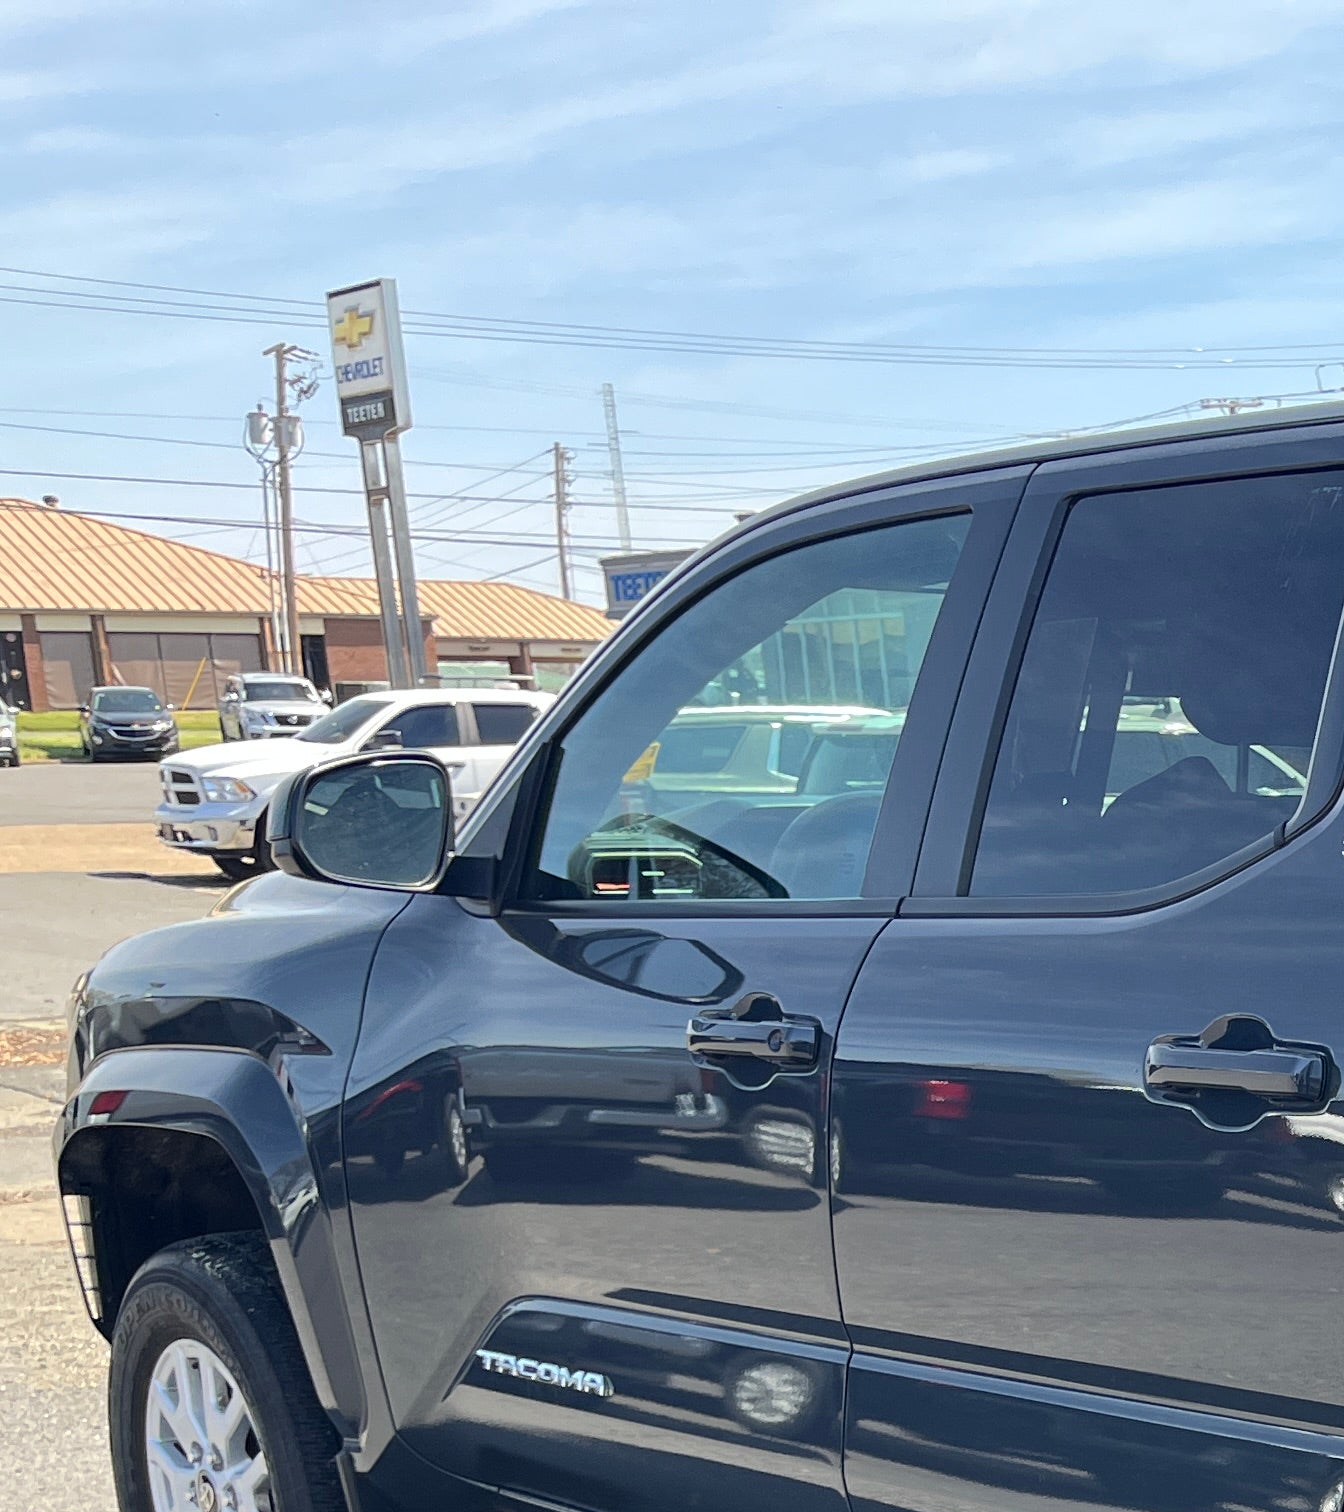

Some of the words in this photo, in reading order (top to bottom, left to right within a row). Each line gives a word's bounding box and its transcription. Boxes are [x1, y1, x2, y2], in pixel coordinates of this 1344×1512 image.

[336, 356, 384, 384] CHEVROLET
[346, 402, 386, 423] TEETER
[475, 1349, 606, 1397] TACOMA
